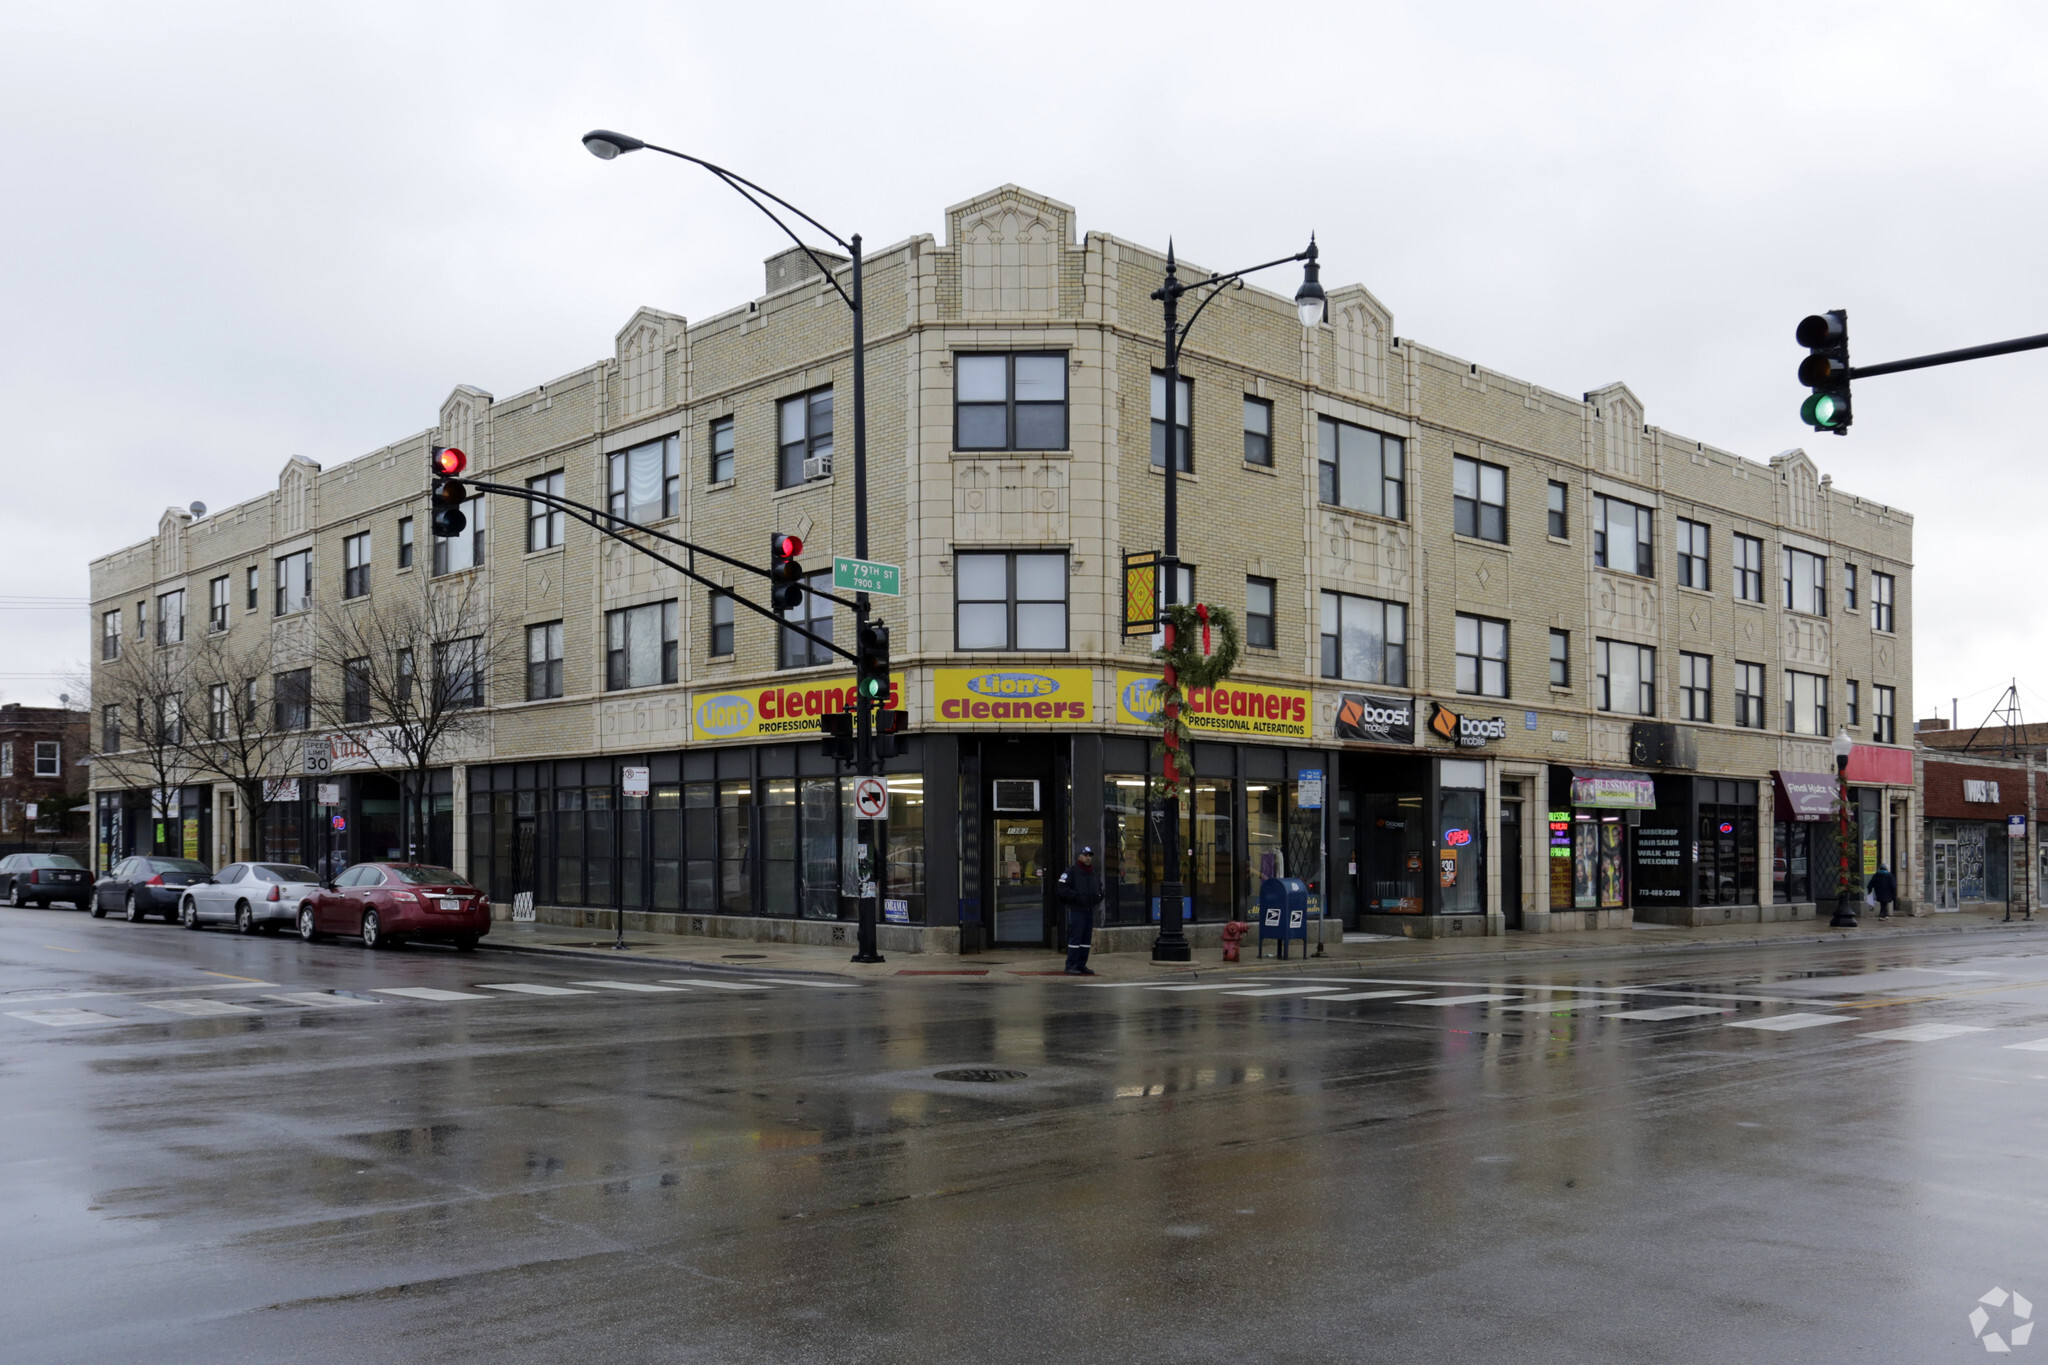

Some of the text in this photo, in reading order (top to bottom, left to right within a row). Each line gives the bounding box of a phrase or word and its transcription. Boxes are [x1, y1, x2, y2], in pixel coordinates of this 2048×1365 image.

[840, 563, 894, 580] W 79TH ST
[853, 577, 882, 590] 7900 S
[978, 676, 1052, 694] Lion's
[759, 682, 899, 720] Cleanes
[941, 698, 1086, 719] Cleaners
[1188, 686, 1306, 722] Cleaners
[702, 701, 750, 729] Lion's
[1364, 703, 1410, 726] boost
[759, 718, 822, 733] PROFESSIONA
[1188, 716, 1305, 735] PROFESSIONAL ALTERATIONS
[1364, 724, 1390, 734] mobile
[1460, 715, 1505, 738] boost
[1461, 736, 1486, 746] mobile
[307, 757, 328, 771] 30
[1595, 779, 1635, 791] BLESSING
[1788, 783, 1828, 795] Final Kutz
[1448, 829, 1469, 846] OPEN
